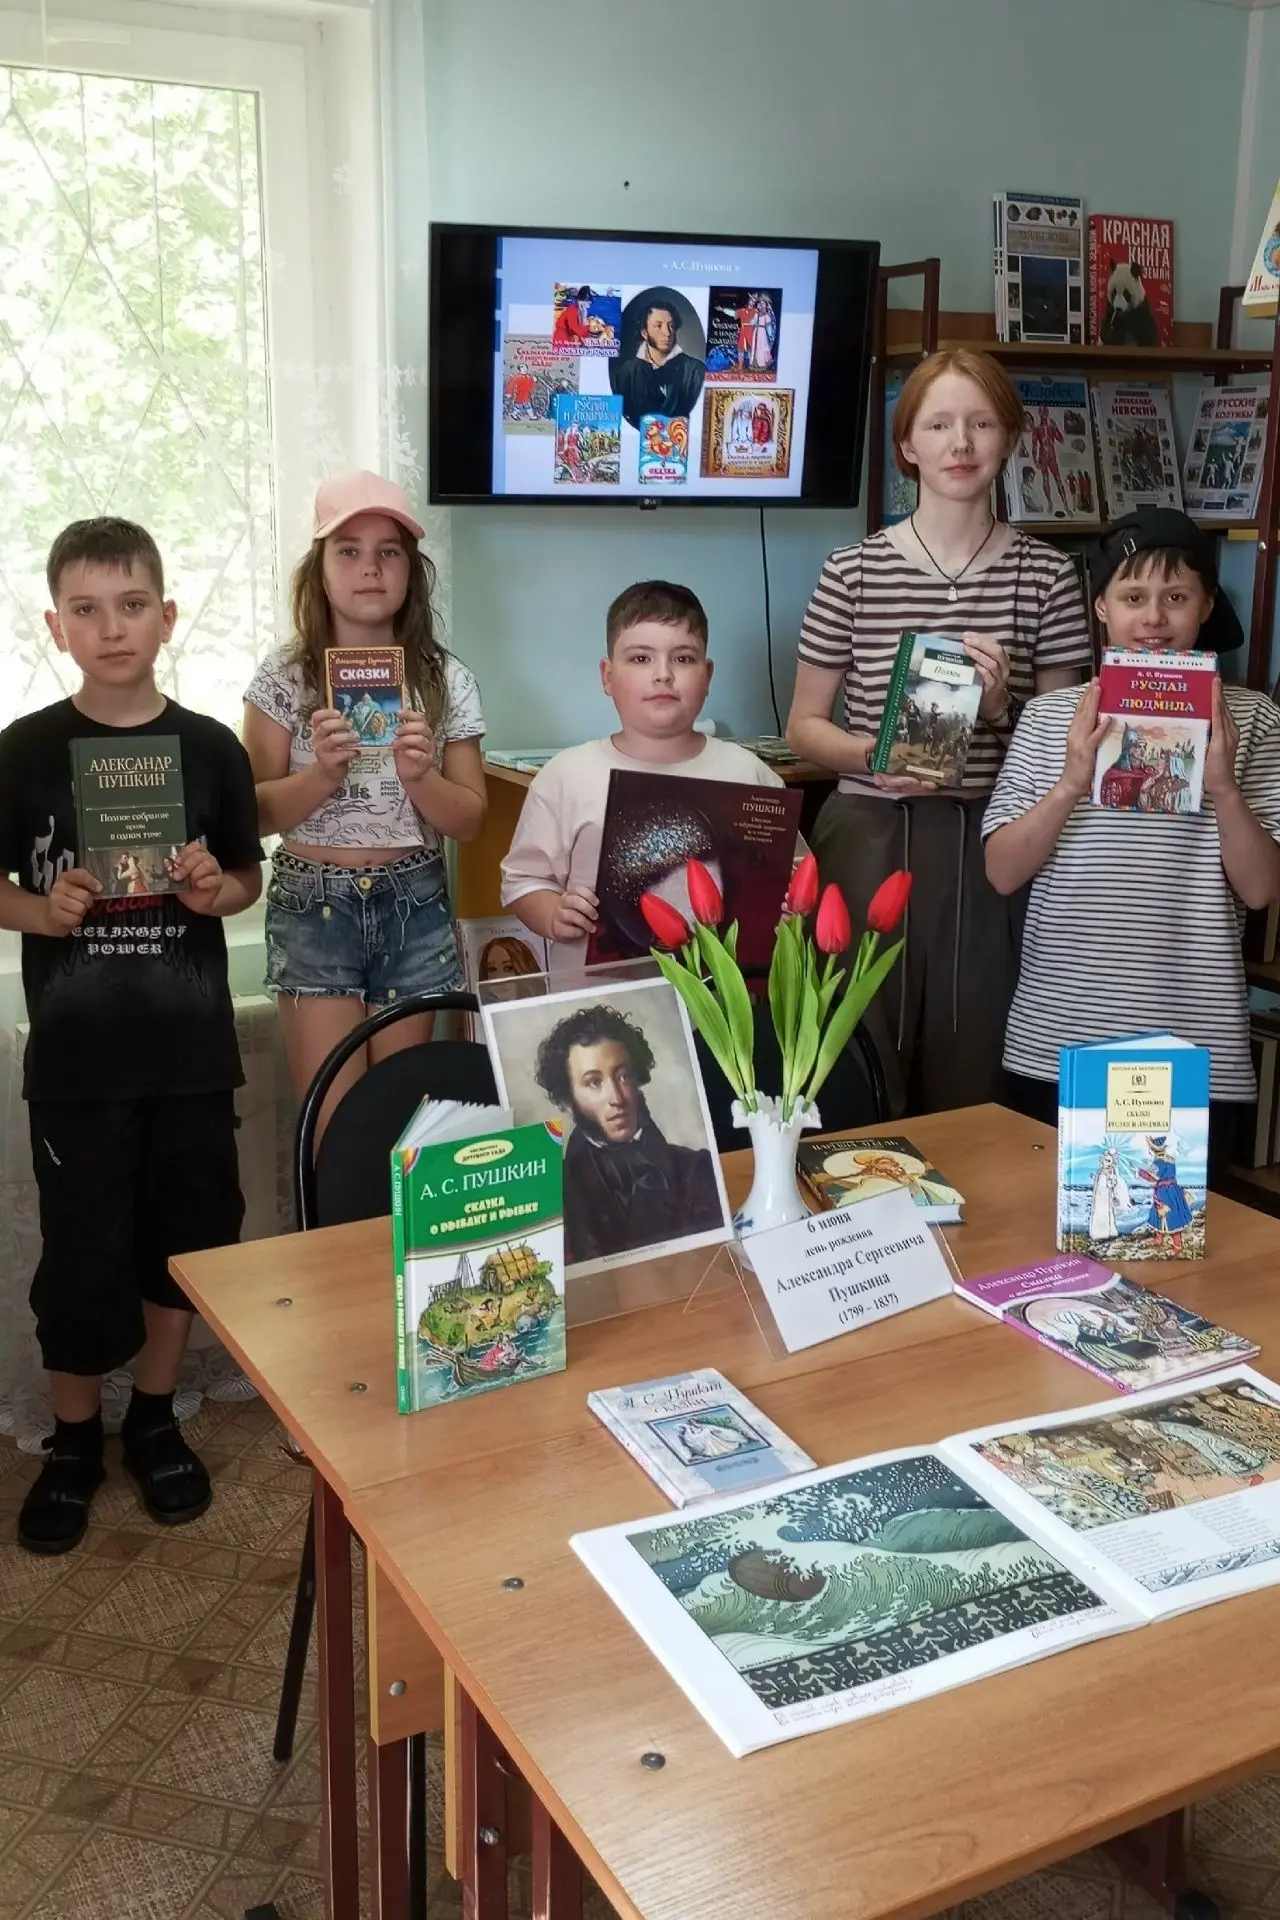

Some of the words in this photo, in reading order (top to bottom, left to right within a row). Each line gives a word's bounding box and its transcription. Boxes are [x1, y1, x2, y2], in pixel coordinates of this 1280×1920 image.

[1103, 219, 1170, 249] КРАСНАЯ
[1128, 246, 1170, 268] КНИГА
[1143, 267, 1170, 280] ЗЕМЛИ
[1111, 404, 1157, 416] НЕВСКИЙ
[1216, 398, 1256, 409] РУССКИЕ
[339, 668, 390, 680] СКАЗКИ
[1130, 680, 1188, 693] РУСЛАН
[1119, 698, 1195, 713] ЛЮДМИЛА
[90, 756, 172, 772] АЛЕКСАНДР
[99, 773, 166, 788] ПУШКИН
[742, 802, 786, 815] ПУШКИН
[100, 813, 131, 822] Полное
[132, 812, 169, 822] собрание
[115, 832, 142, 840] одном
[71, 926, 162, 940] EELINGS
[165, 925, 187, 938] OF
[87, 944, 162, 956] POWER
[420, 1183, 437, 1200] А.
[441, 1179, 458, 1195] С.
[463, 1158, 546, 1191] ПУШКИН
[464, 1196, 505, 1214] СКАЗКА
[440, 1213, 488, 1233] РЫБАКЕ
[499, 1202, 539, 1220] РЫБКЕ
[806, 1221, 817, 1234] 6
[818, 1211, 852, 1230] июня
[804, 1241, 828, 1259] день
[828, 1228, 873, 1252] рождения
[776, 1259, 854, 1294] Александра
[854, 1233, 926, 1266] Сергеевича
[978, 1271, 1037, 1292] Александр
[1034, 1258, 1082, 1276] Пушкин
[828, 1272, 891, 1303] Пушкина
[839, 1304, 865, 1325] (1799
[873, 1292, 899, 1312] 1837)
